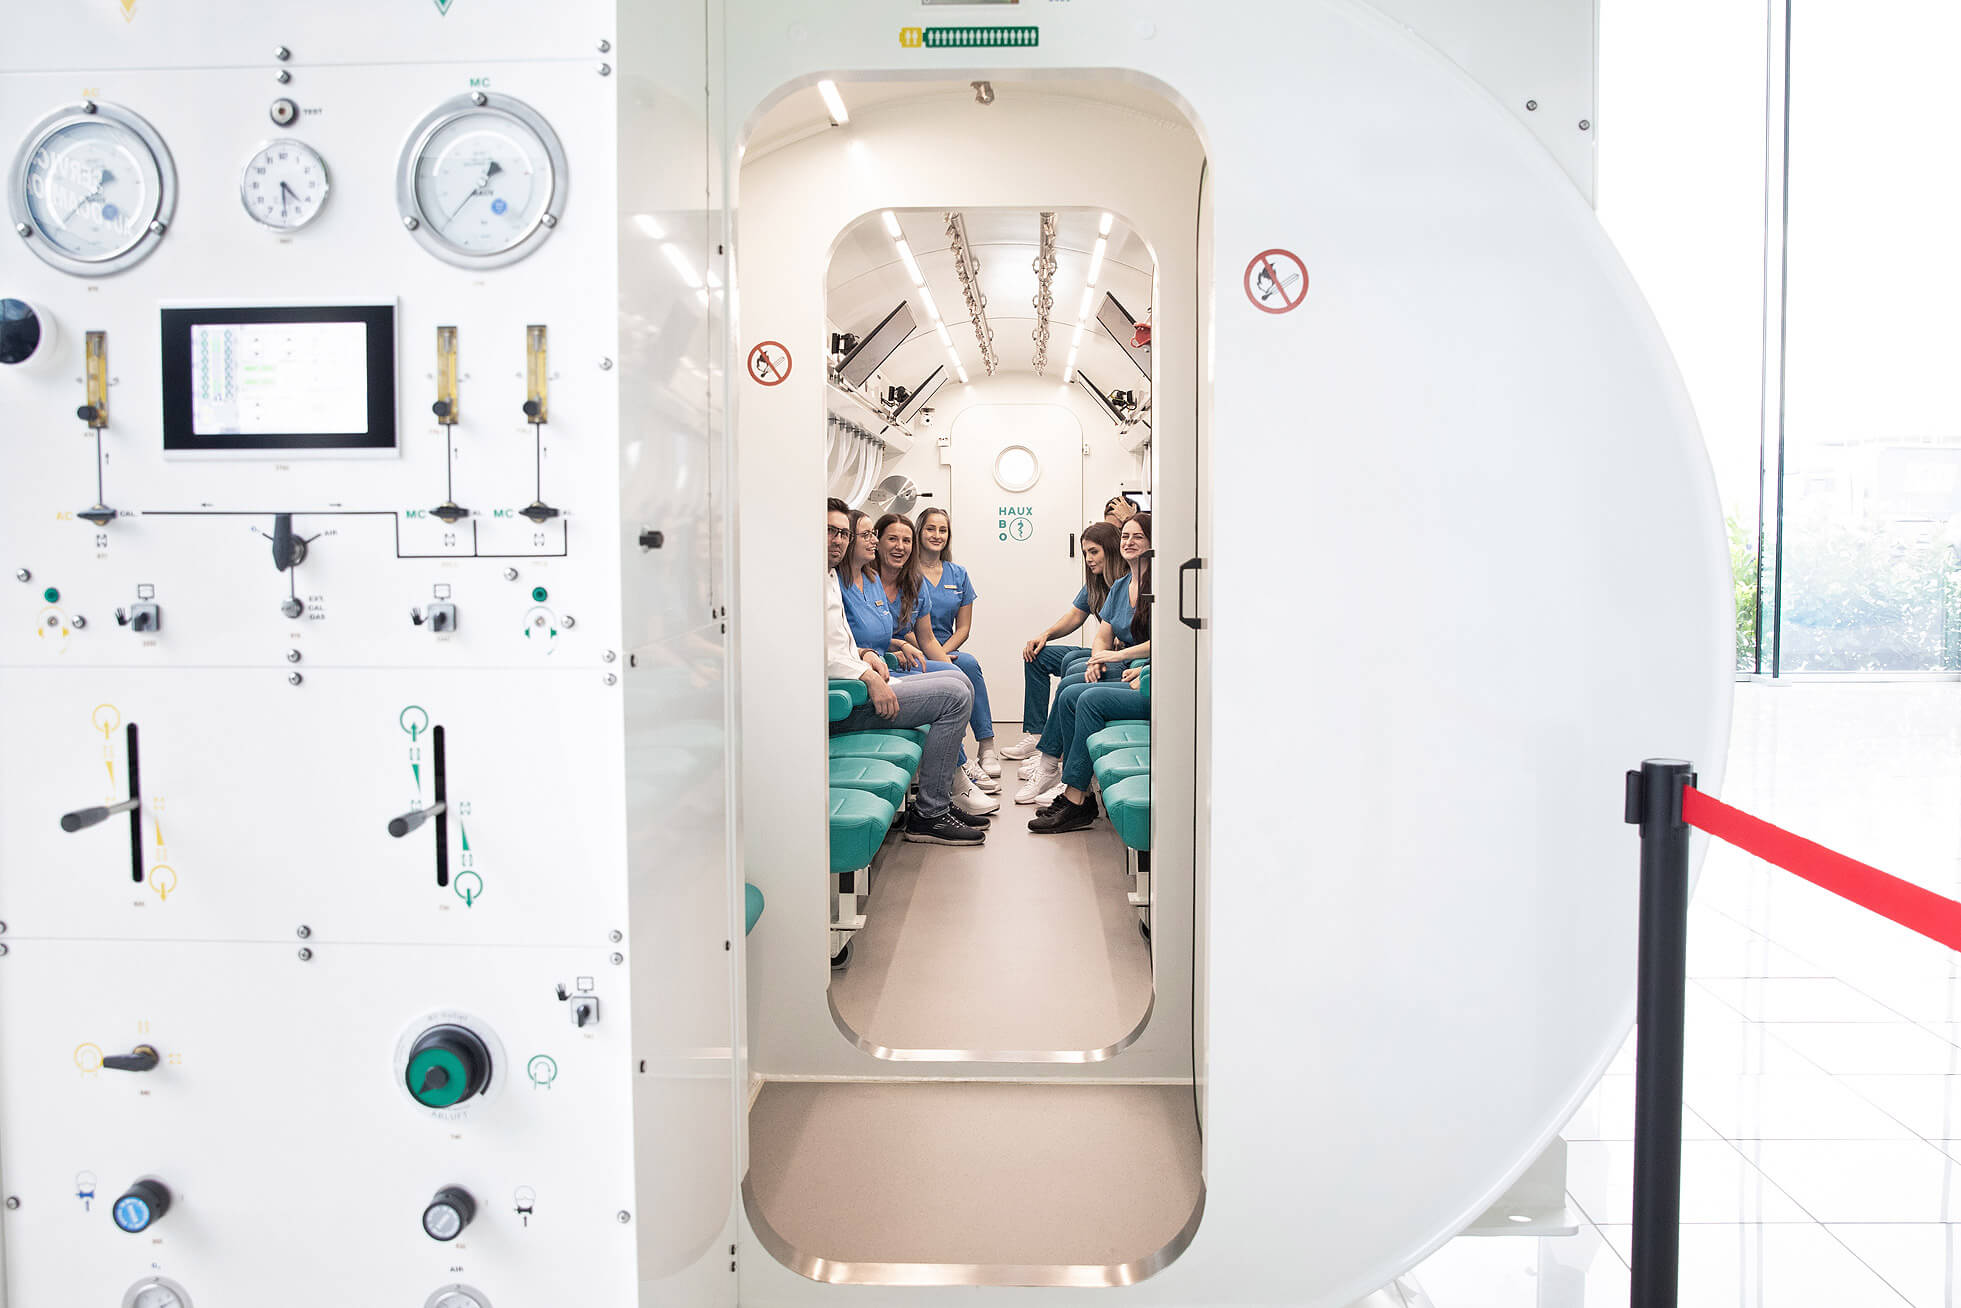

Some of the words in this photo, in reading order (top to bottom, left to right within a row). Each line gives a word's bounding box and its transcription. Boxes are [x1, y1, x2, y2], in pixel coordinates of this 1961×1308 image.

[469, 77, 491, 88] MC
[82, 88, 100, 97] AC
[56, 511, 73, 520] AC
[406, 510, 426, 519] MC
[493, 509, 513, 518] MC
[999, 507, 1033, 516] HAUX
